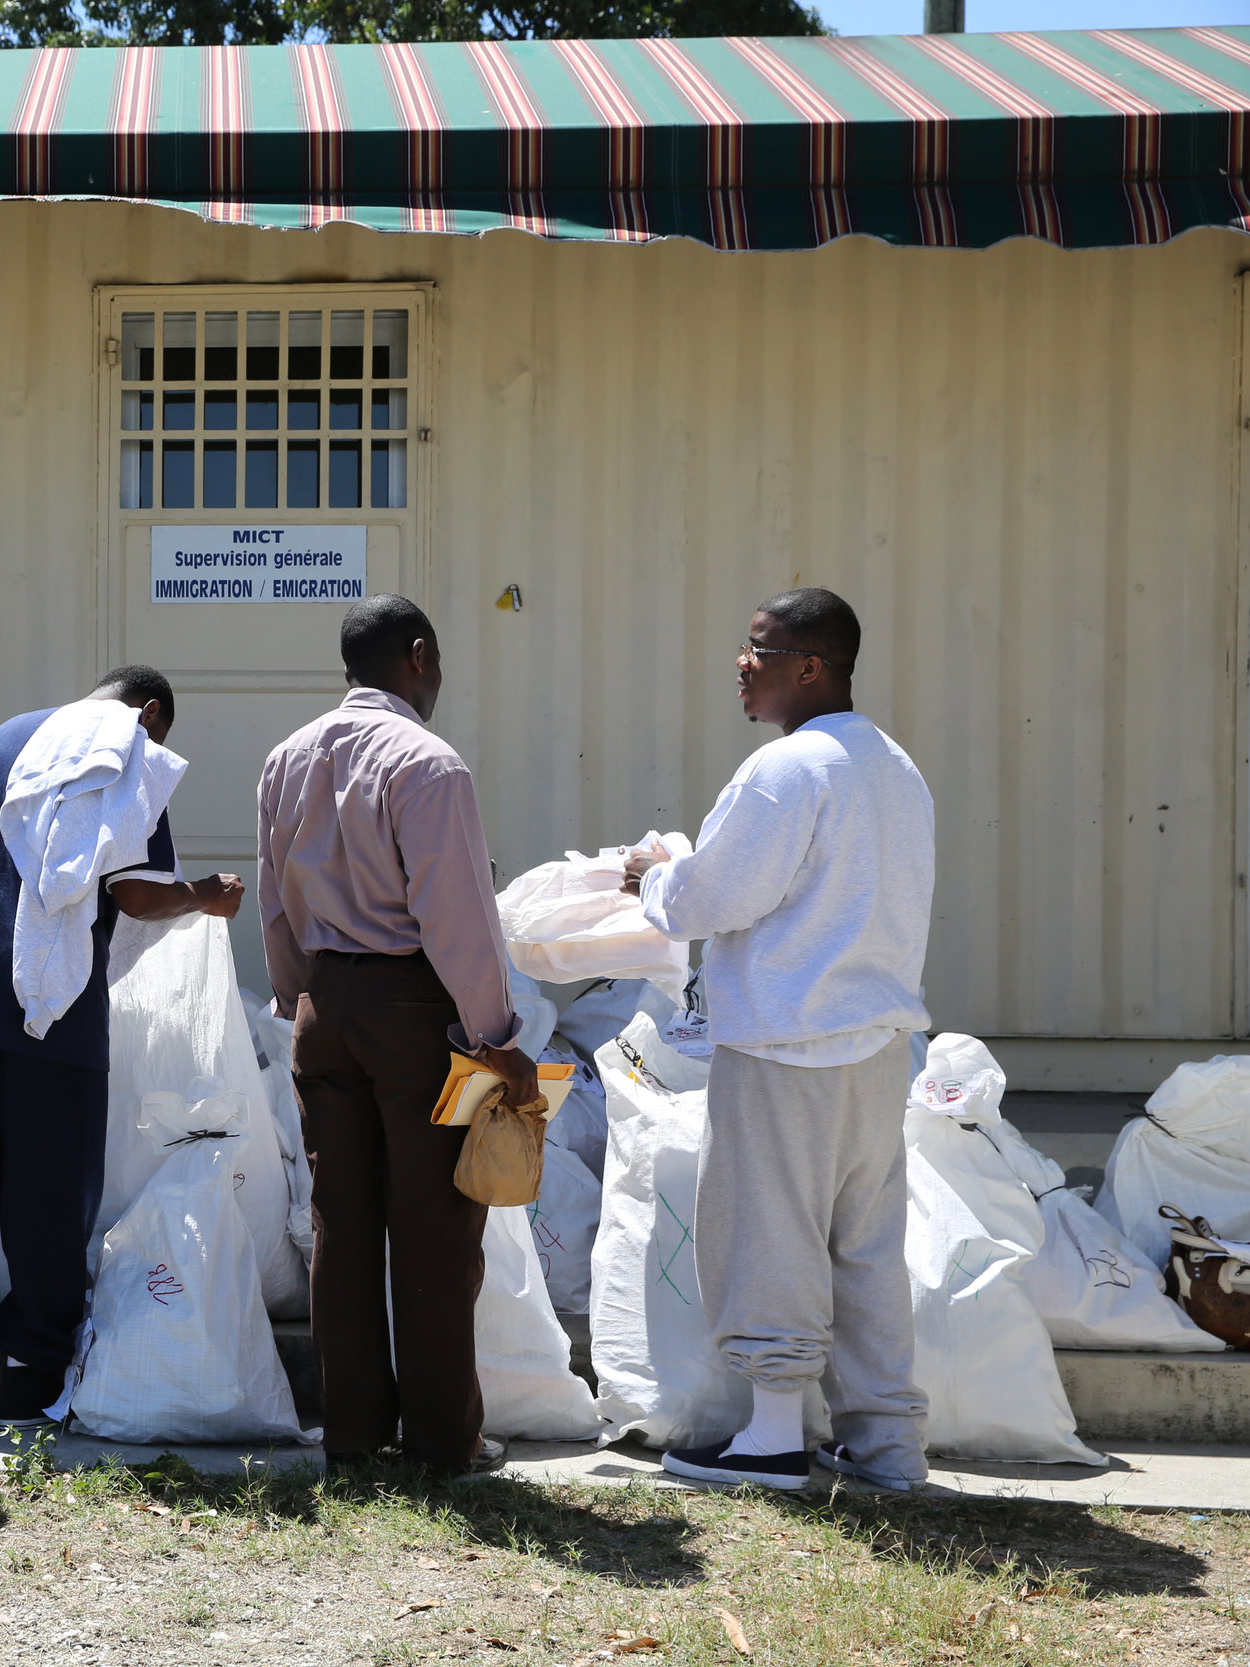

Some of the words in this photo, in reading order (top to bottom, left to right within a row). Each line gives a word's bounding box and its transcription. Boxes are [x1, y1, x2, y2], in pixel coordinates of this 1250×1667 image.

[233, 530, 284, 543] MICT
[174, 551, 267, 569] Supervision
[273, 549, 343, 569] générale
[155, 579, 252, 598] IMMIGRATION
[259, 579, 266, 598] /
[272, 579, 362, 598] EMIGRATION
